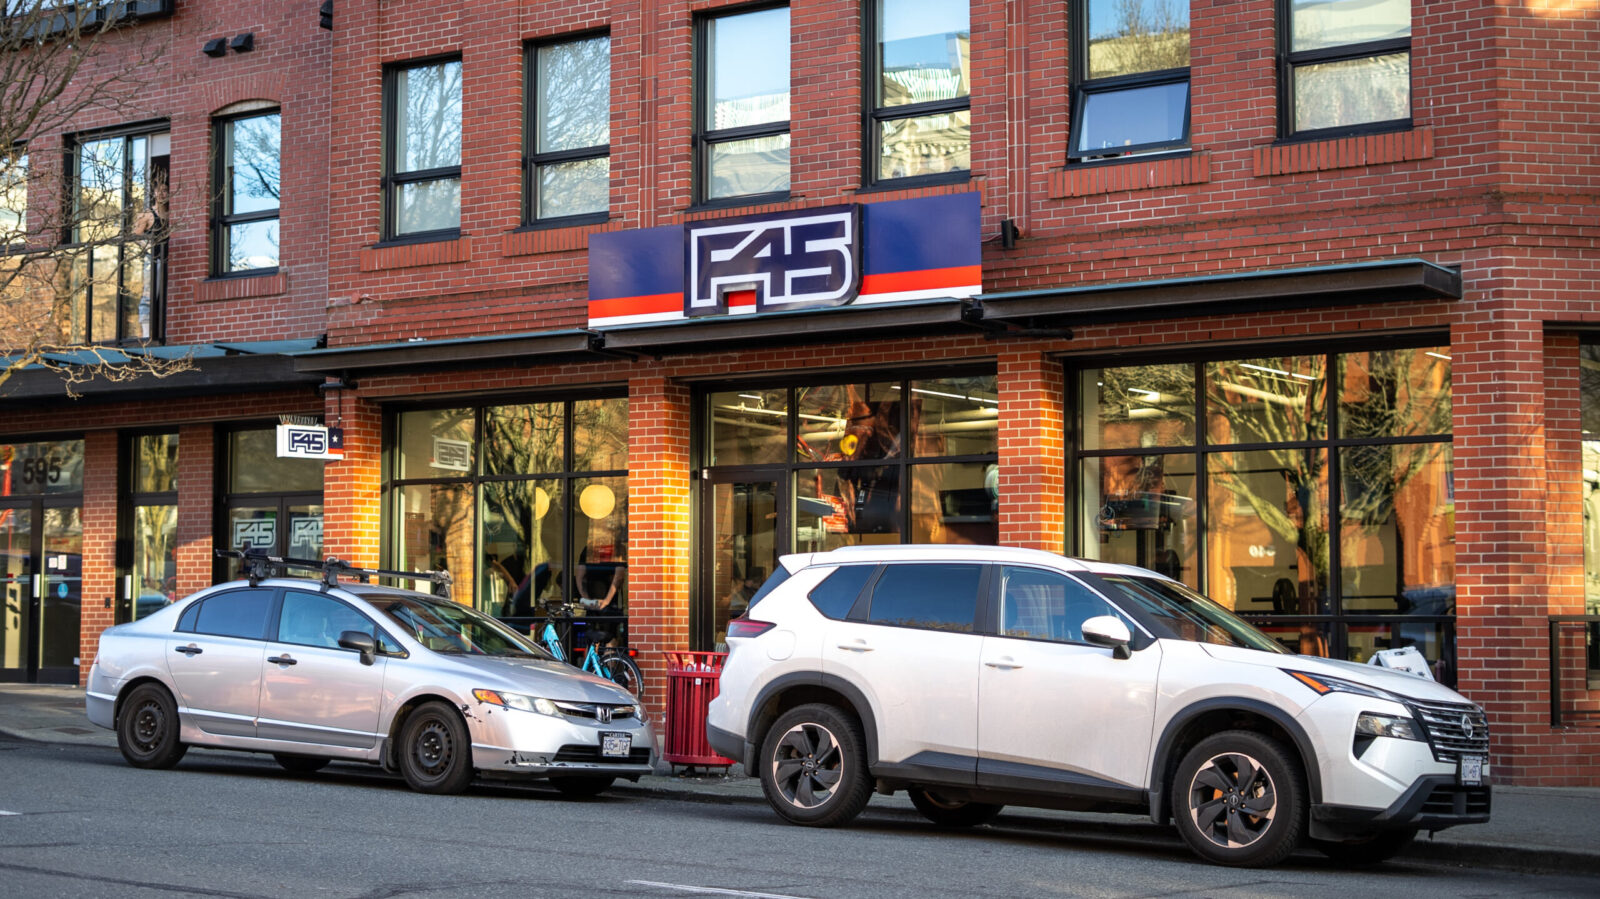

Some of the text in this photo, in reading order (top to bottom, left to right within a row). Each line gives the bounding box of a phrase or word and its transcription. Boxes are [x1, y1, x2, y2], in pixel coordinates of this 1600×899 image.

[691, 212, 852, 308] F45
[289, 430, 325, 453] F45
[23, 457, 61, 485] 595
[234, 519, 275, 547] F45
